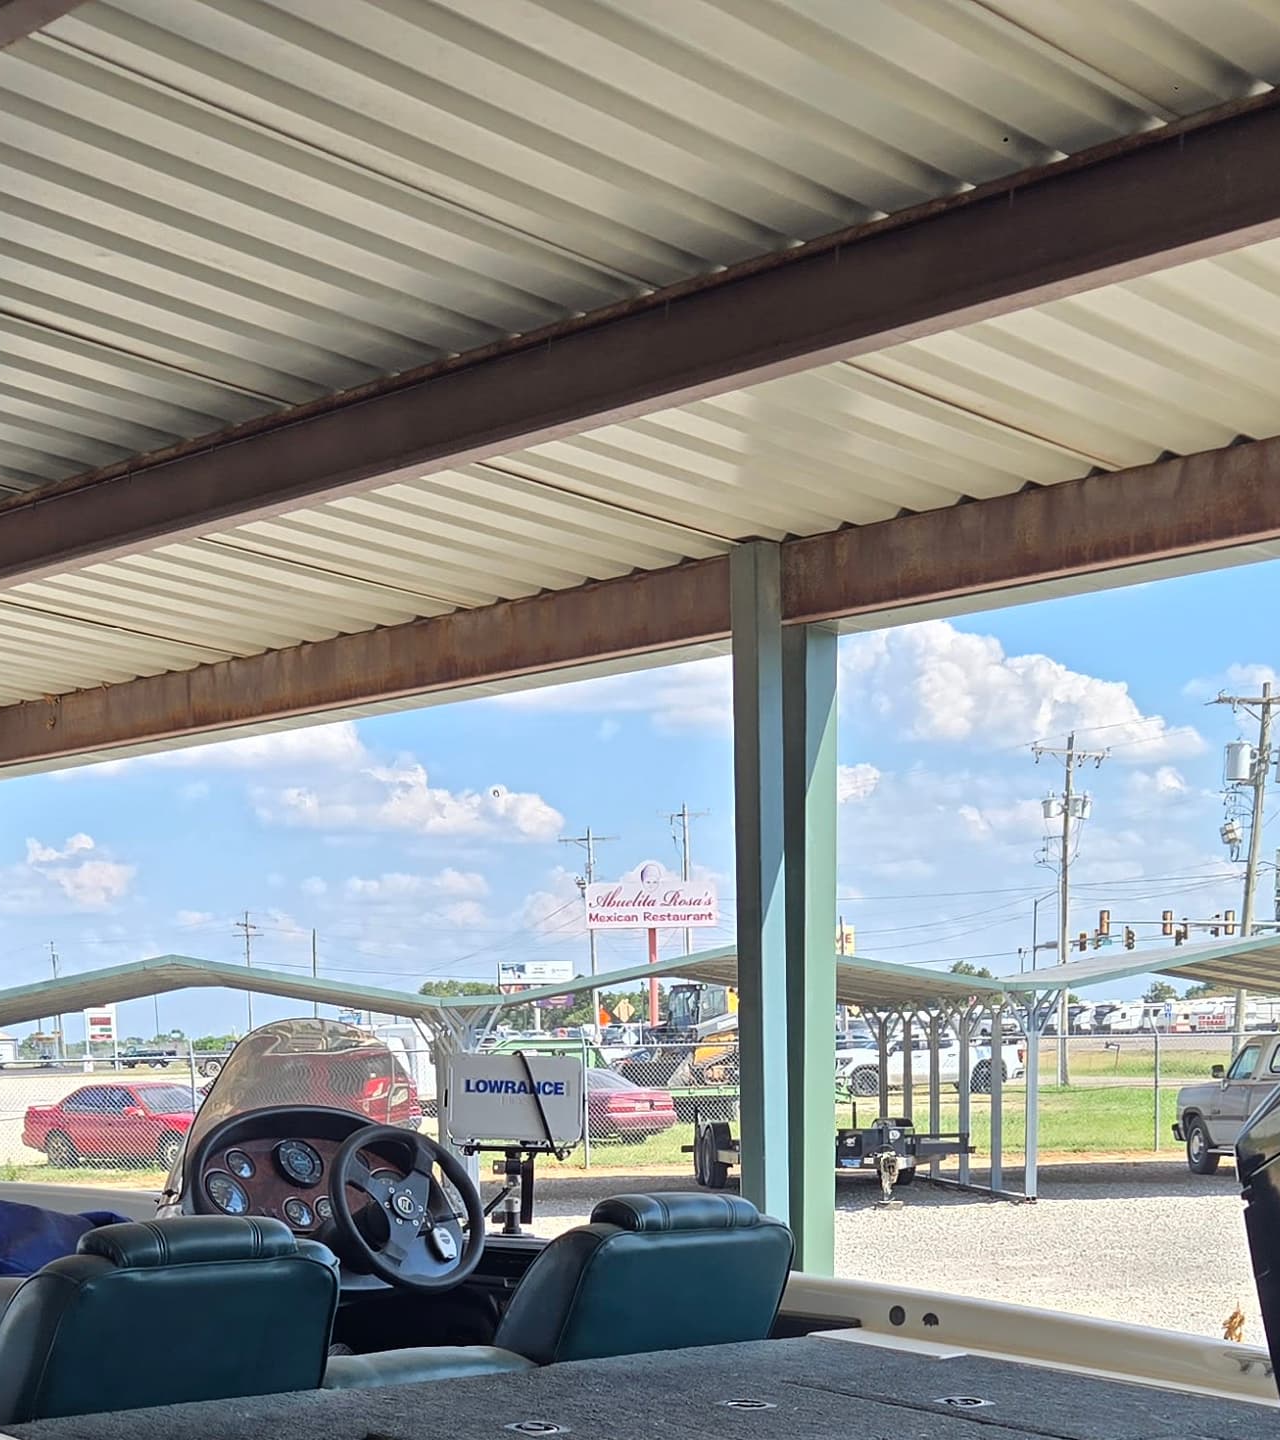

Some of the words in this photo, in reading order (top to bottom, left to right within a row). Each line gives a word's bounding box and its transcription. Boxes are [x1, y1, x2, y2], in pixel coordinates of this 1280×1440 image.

[589, 886, 656, 908] Abuelita
[660, 889, 713, 907] Rosa's
[589, 912, 639, 922] Mexican
[643, 911, 713, 922] Restaurant
[464, 1079, 565, 1096] LOWRANCE
